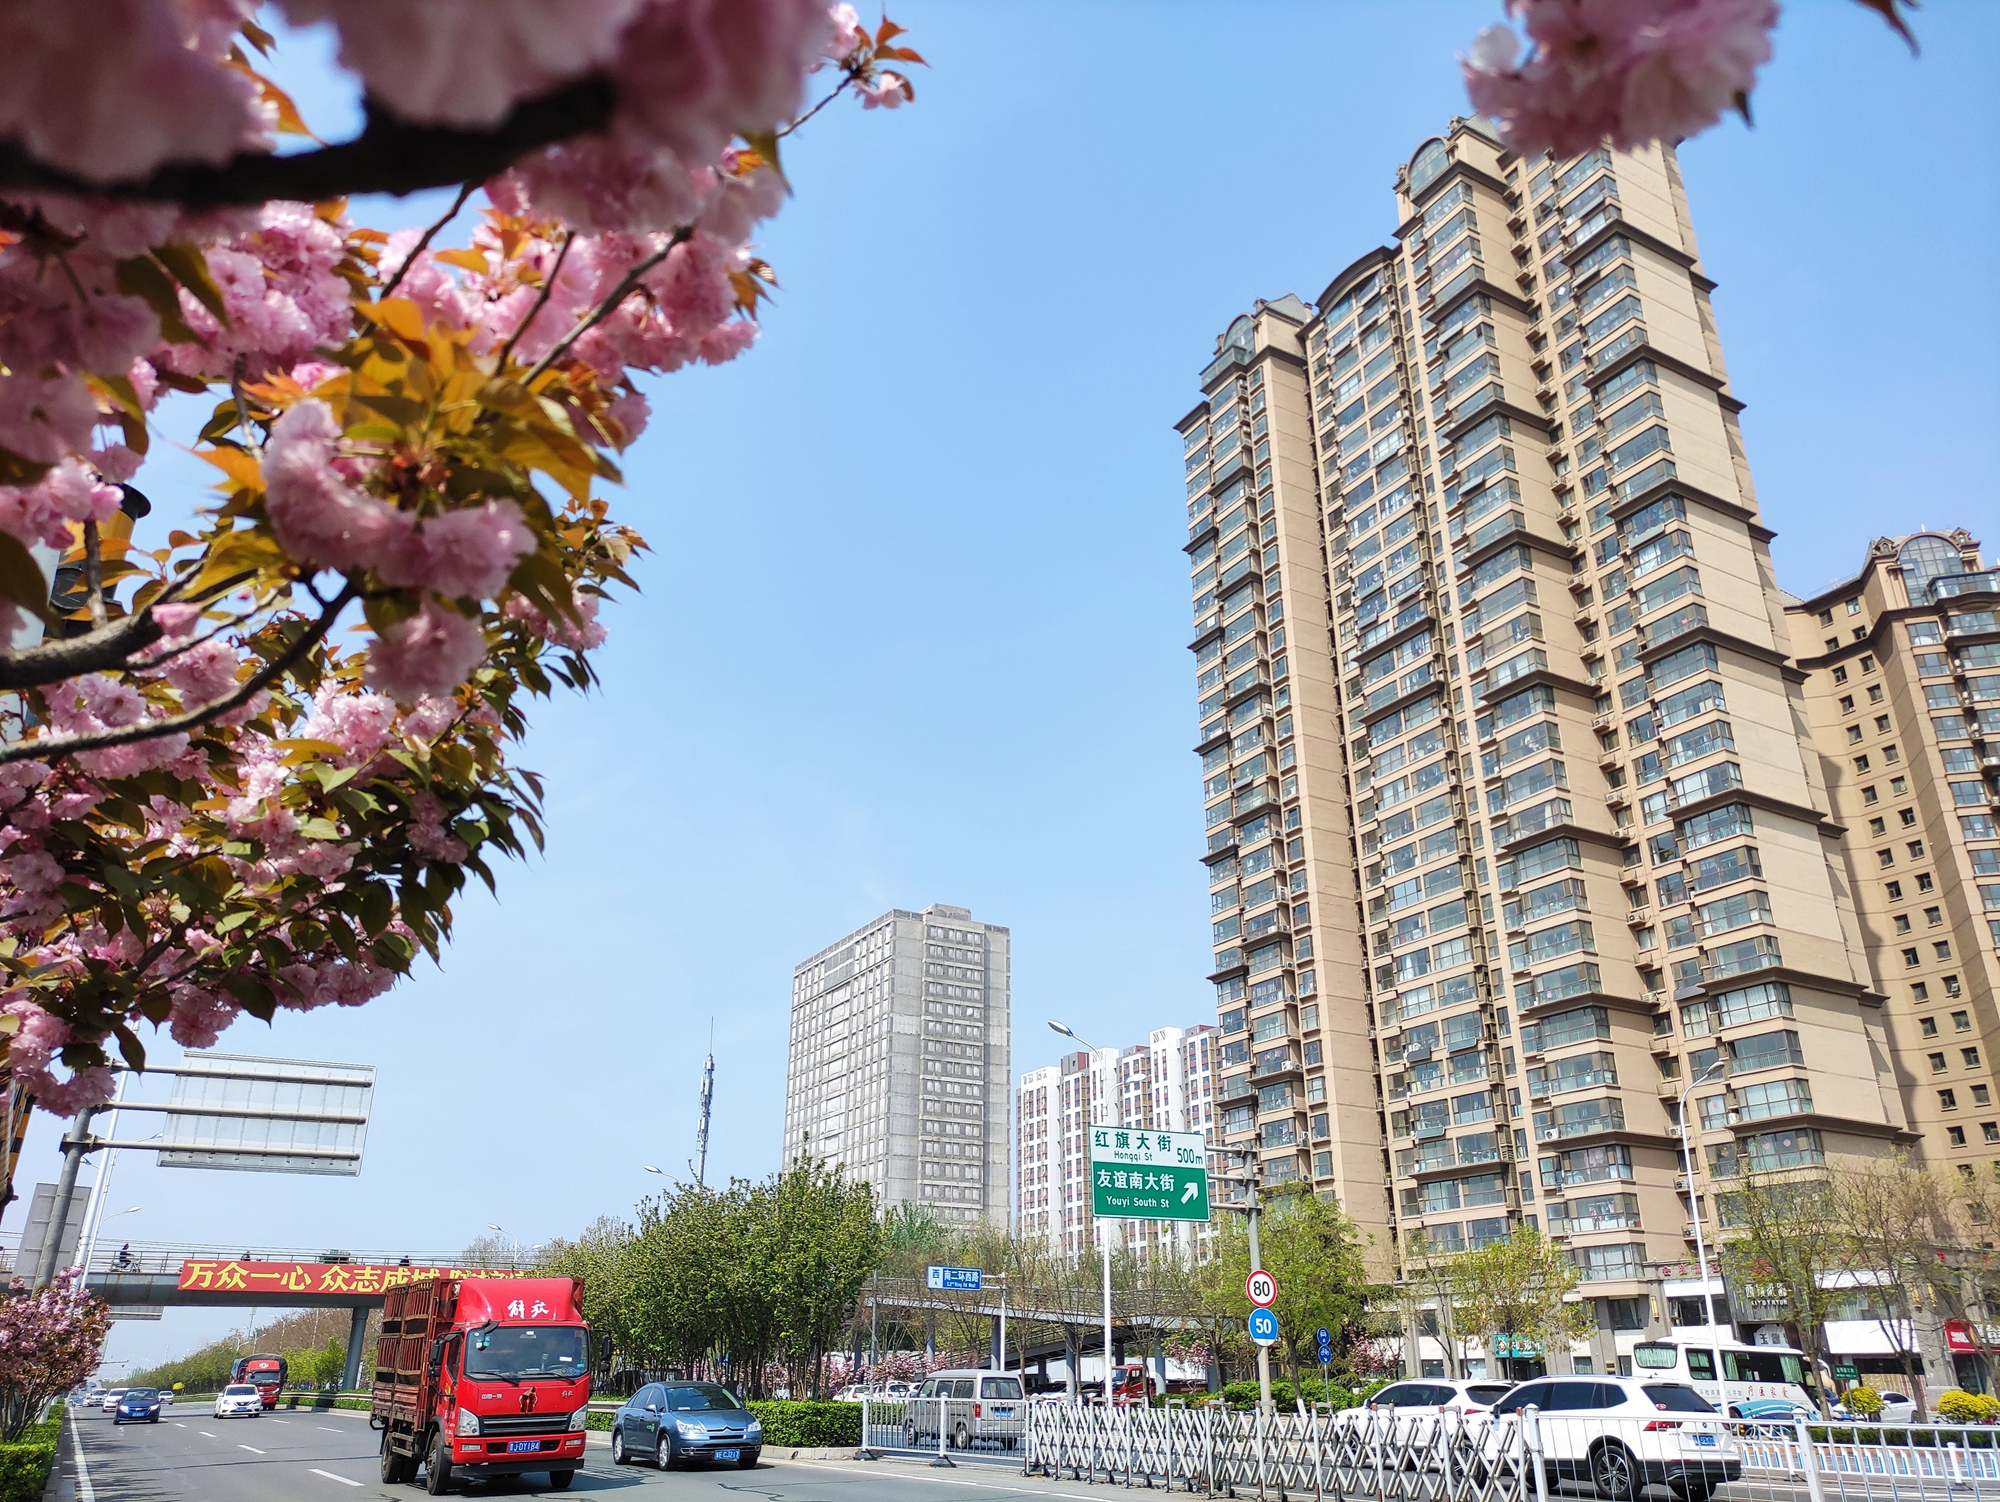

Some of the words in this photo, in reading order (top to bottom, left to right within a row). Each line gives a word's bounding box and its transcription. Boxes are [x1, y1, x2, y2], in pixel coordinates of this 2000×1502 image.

[1094, 1130, 1171, 1152] 红旗大街
[1114, 1151, 1141, 1162] Hongqi
[1144, 1152, 1153, 1161] St
[1176, 1147, 1203, 1165] 500m
[1097, 1168, 1175, 1192] 友谊南大街
[1106, 1195, 1130, 1208] Youyi
[1133, 1197, 1157, 1208] South
[1160, 1198, 1170, 1208] St
[181, 1261, 312, 1291] 万众一心
[943, 1269, 979, 1283] 南二环西路
[1253, 1280, 1270, 1297] 80
[507, 1299, 549, 1319] 解放
[1255, 1317, 1272, 1335] 50
